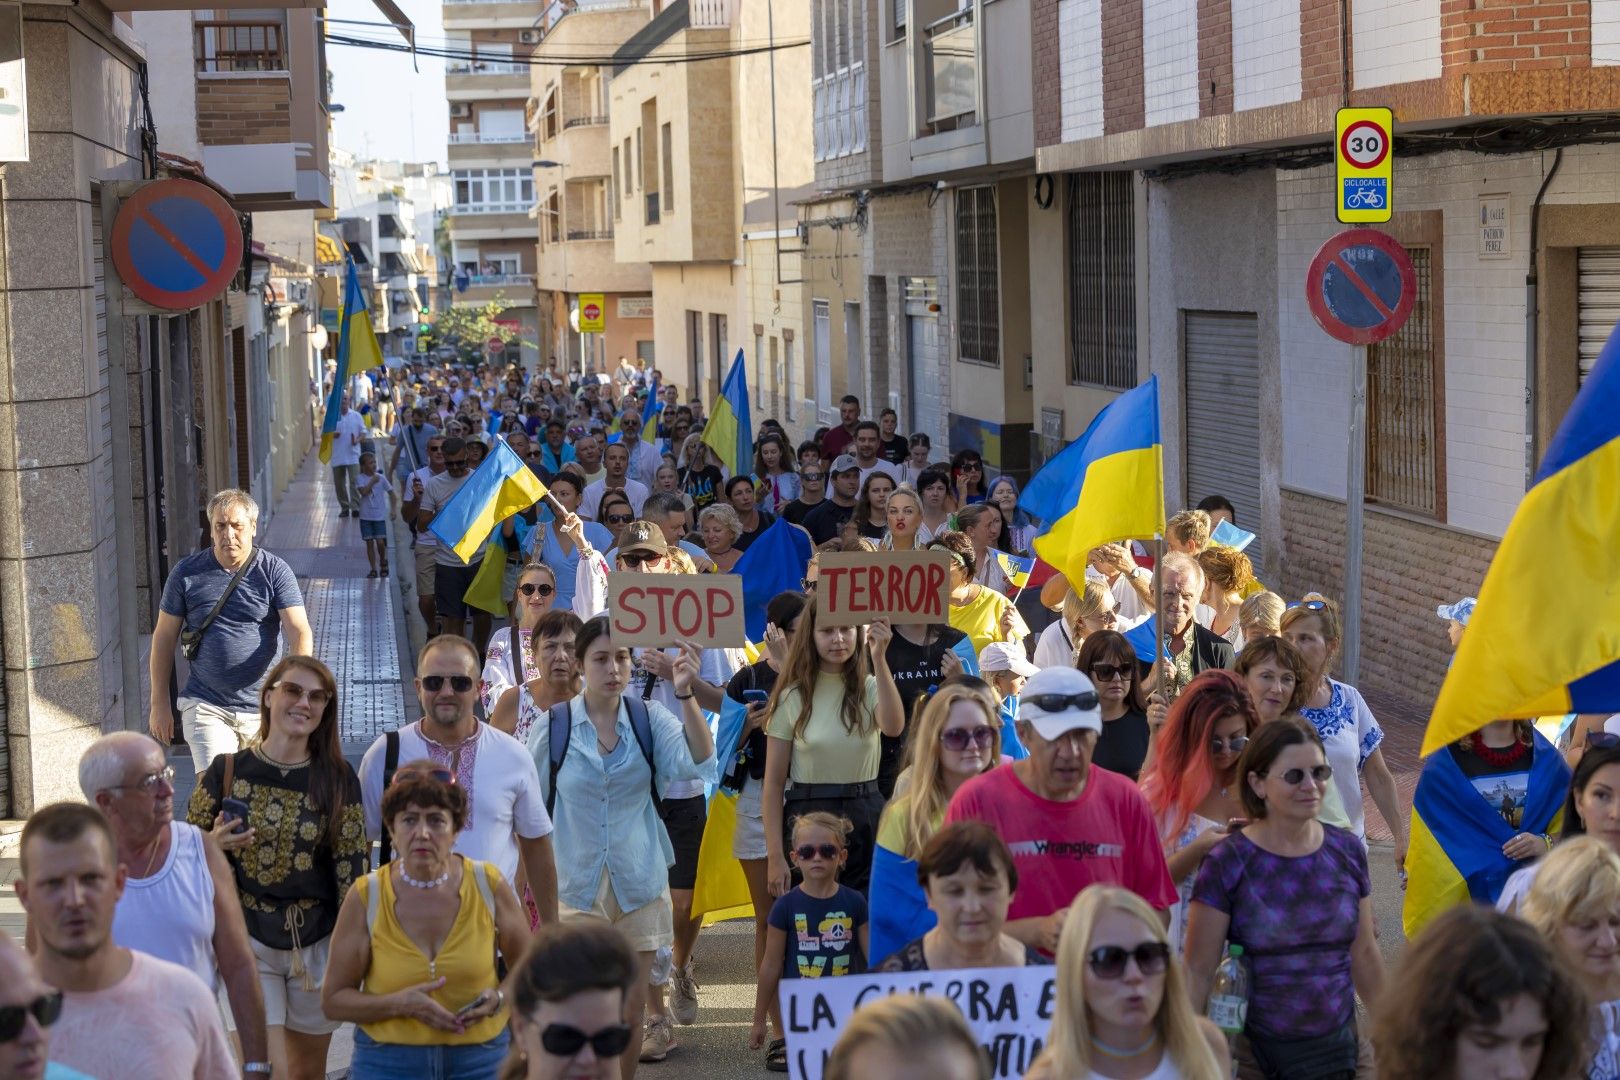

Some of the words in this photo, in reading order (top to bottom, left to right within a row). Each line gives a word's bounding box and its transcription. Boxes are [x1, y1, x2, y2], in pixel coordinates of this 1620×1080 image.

[1351, 137, 1379, 153] 30
[1344, 178, 1387, 187] CICLOCALLE
[638, 529, 649, 541] NY
[820, 563, 945, 616] TERROR
[615, 586, 735, 639] STOP
[1033, 840, 1100, 861] Wrangler
[789, 992, 836, 1032] LA
